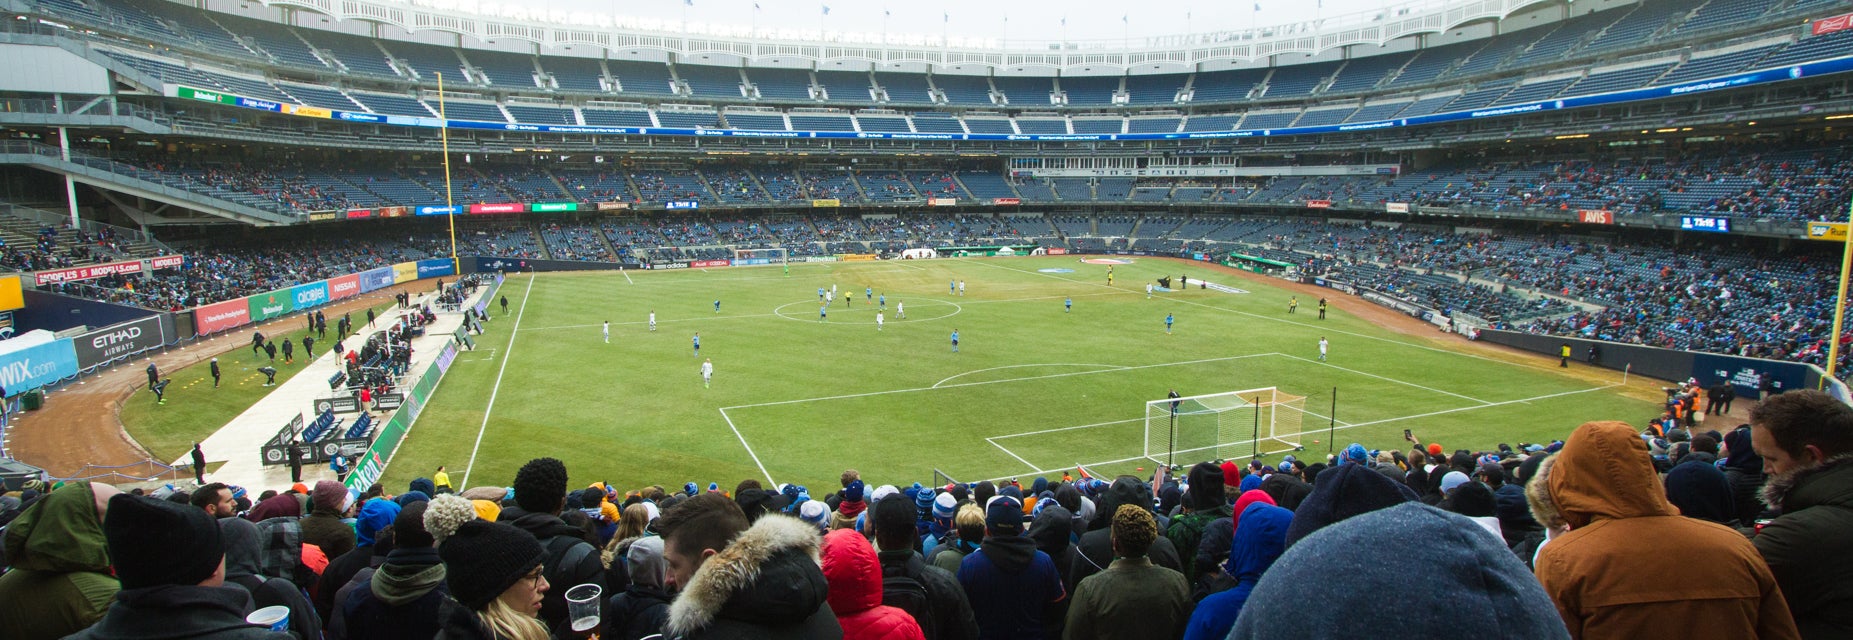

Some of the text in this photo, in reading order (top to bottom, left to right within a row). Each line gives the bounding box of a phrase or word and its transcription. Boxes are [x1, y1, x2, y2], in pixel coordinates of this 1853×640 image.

[1584, 212, 1606, 224] AVIS
[334, 280, 356, 293] NISSAN
[93, 326, 141, 348] ETIHAD
[104, 342, 134, 357] AIRWAYS
